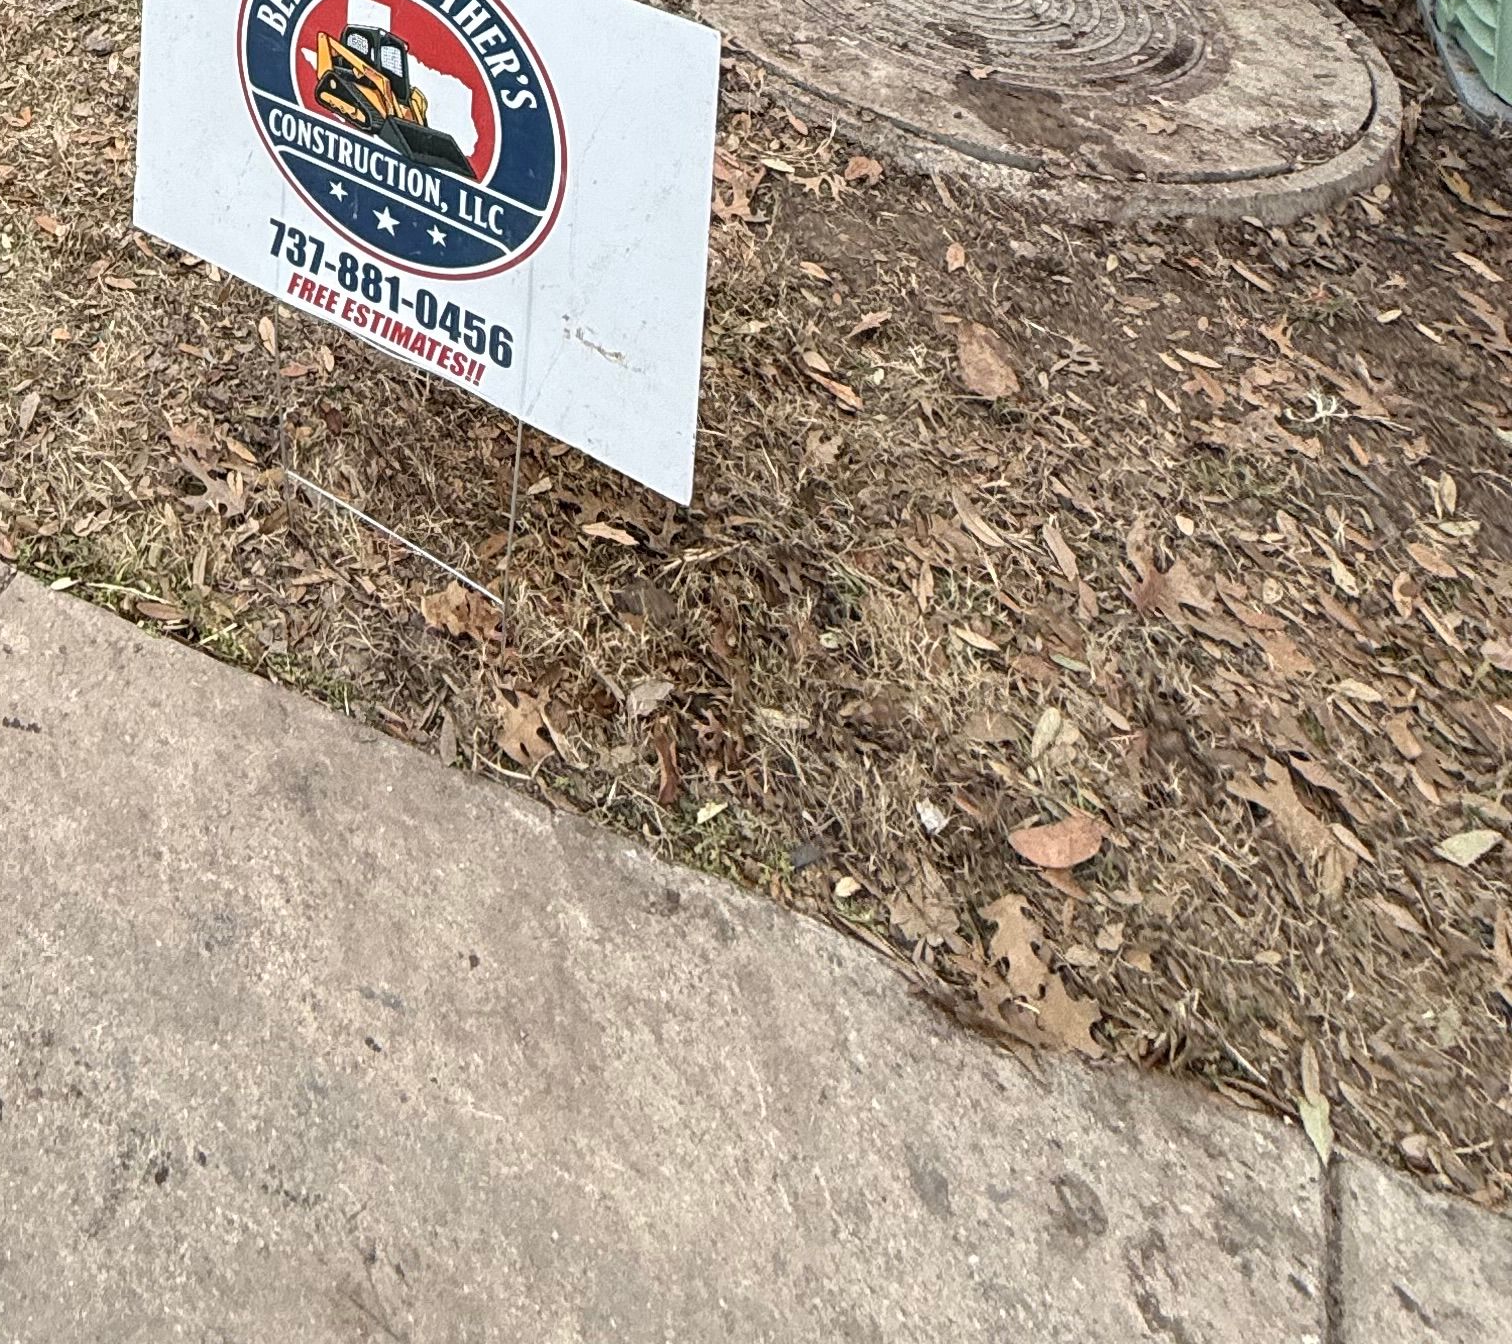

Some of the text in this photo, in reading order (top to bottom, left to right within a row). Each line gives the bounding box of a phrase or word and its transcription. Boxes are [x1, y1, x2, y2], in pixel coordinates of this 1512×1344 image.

[268, 108, 504, 236] CONSTRUCTION, LLC
[269, 217, 514, 368] 737-881-0456
[286, 272, 486, 386] FREE ESTIMATES!!
